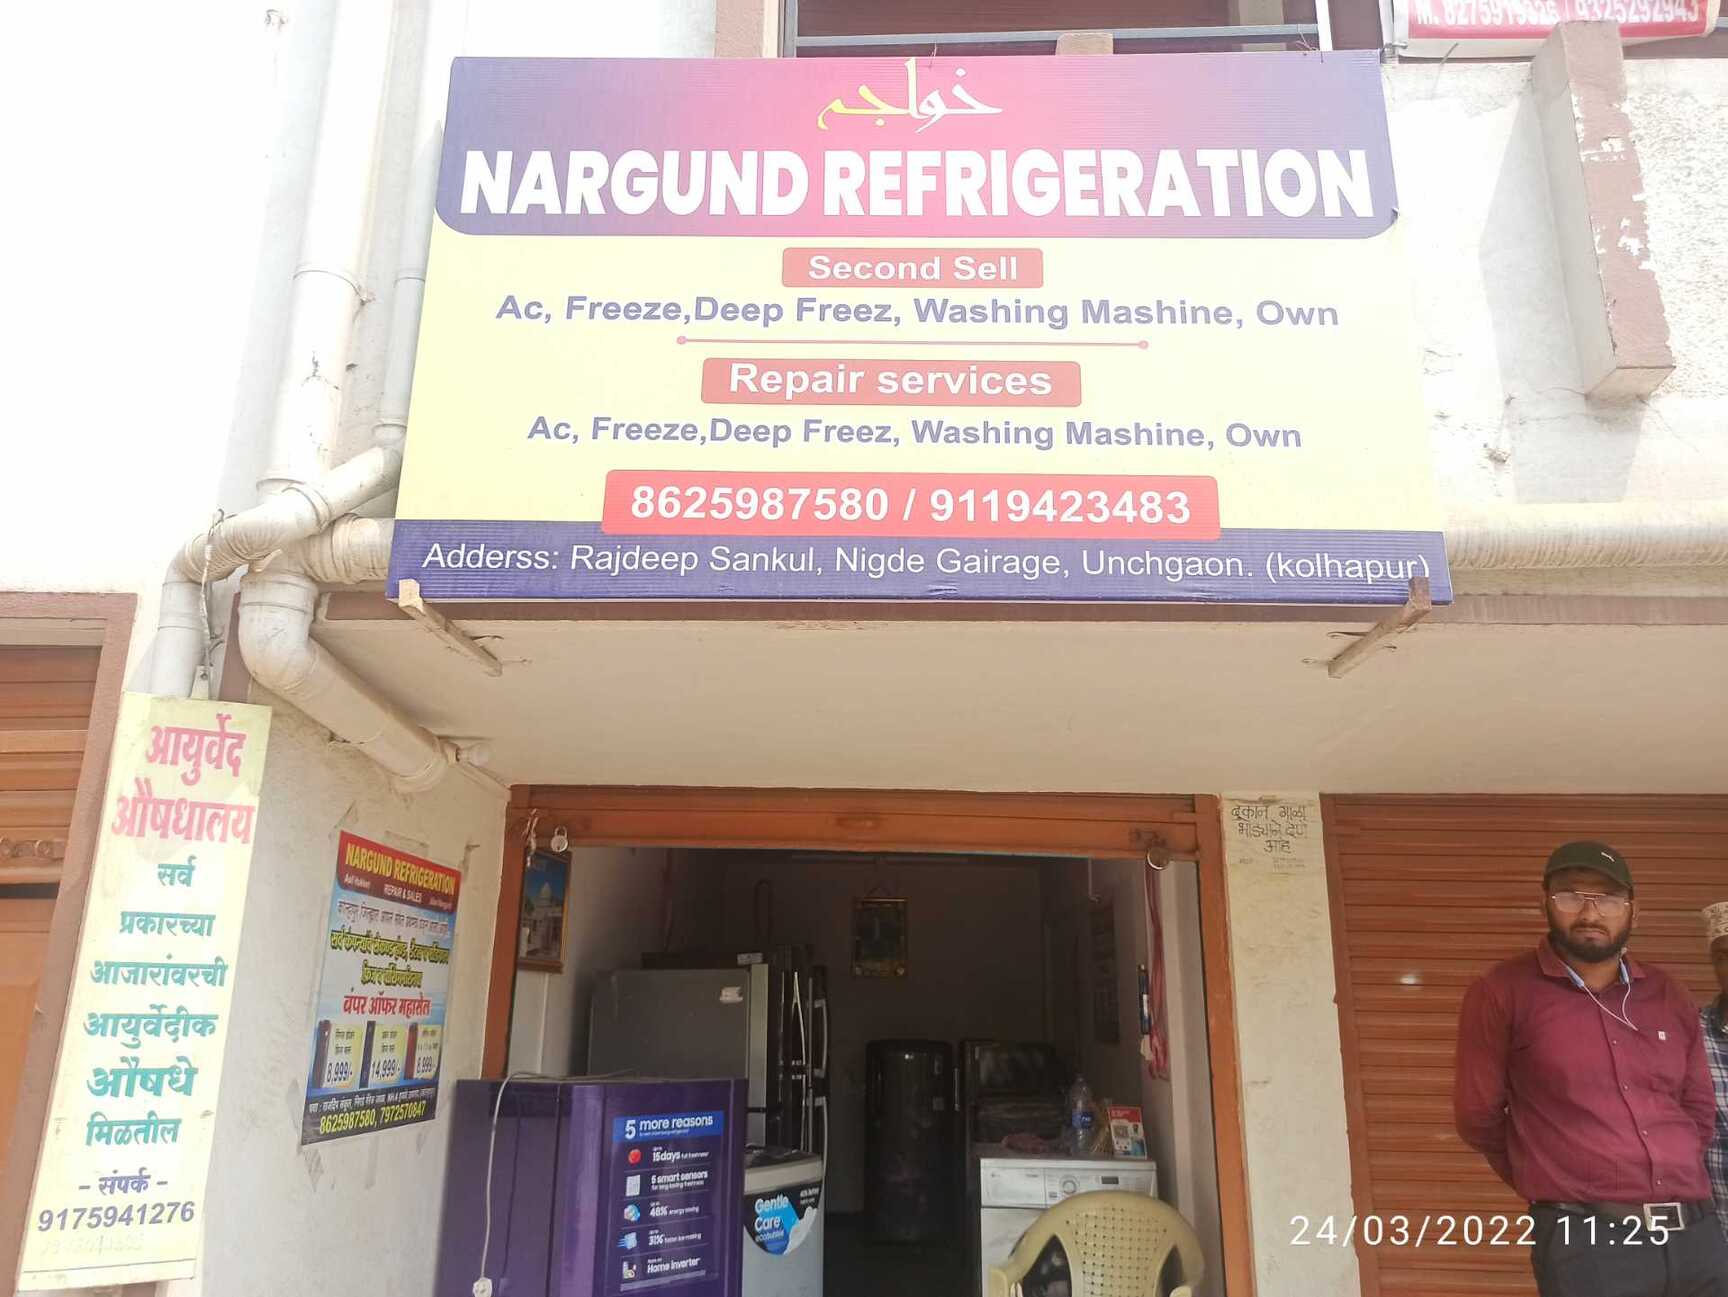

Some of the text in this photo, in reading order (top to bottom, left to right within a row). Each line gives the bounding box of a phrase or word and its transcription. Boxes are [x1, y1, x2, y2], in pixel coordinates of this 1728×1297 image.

[459, 148, 1375, 218] NARGUND REFRIGERATION
[807, 254, 1018, 282] Second Sell
[495, 295, 552, 324] Ac,
[796, 298, 901, 326] Freez,
[913, 298, 1069, 330] Washing
[1081, 300, 1243, 330] Mashine,
[1256, 301, 1339, 326] Own
[729, 362, 1053, 400] Repair services
[527, 415, 579, 444] Ac,
[803, 418, 900, 446] Freez,
[912, 420, 1054, 450] Washing
[1066, 422, 1215, 450] Mashine,
[1225, 423, 1302, 448] Own
[630, 486, 1191, 525] 8625987580 / 9119423483
[421, 542, 1430, 582] Adderss: Rajdeep Sankul, Nigde Gairage, Unchgaon. (kolhapur)
[145, 712, 247, 786] आयुर्वेद
[157, 855, 198, 888] सर्व
[345, 842, 394, 877] NARGUND
[394, 858, 457, 896] REFRIGERATION
[119, 911, 217, 937] प्रकारच्या
[90, 954, 229, 987] आजारांवरची
[83, 1004, 219, 1049] आयुर्वेदीक
[85, 1110, 182, 1146] मिळतील
[624, 1119, 637, 1140] 5
[639, 1118, 670, 1131] more
[672, 1115, 713, 1129] reasons
[98, 1167, 151, 1196] संपर्क
[37, 1201, 197, 1232] 9175941276
[754, 1193, 789, 1213] Gentle
[754, 1215, 781, 1233] Care
